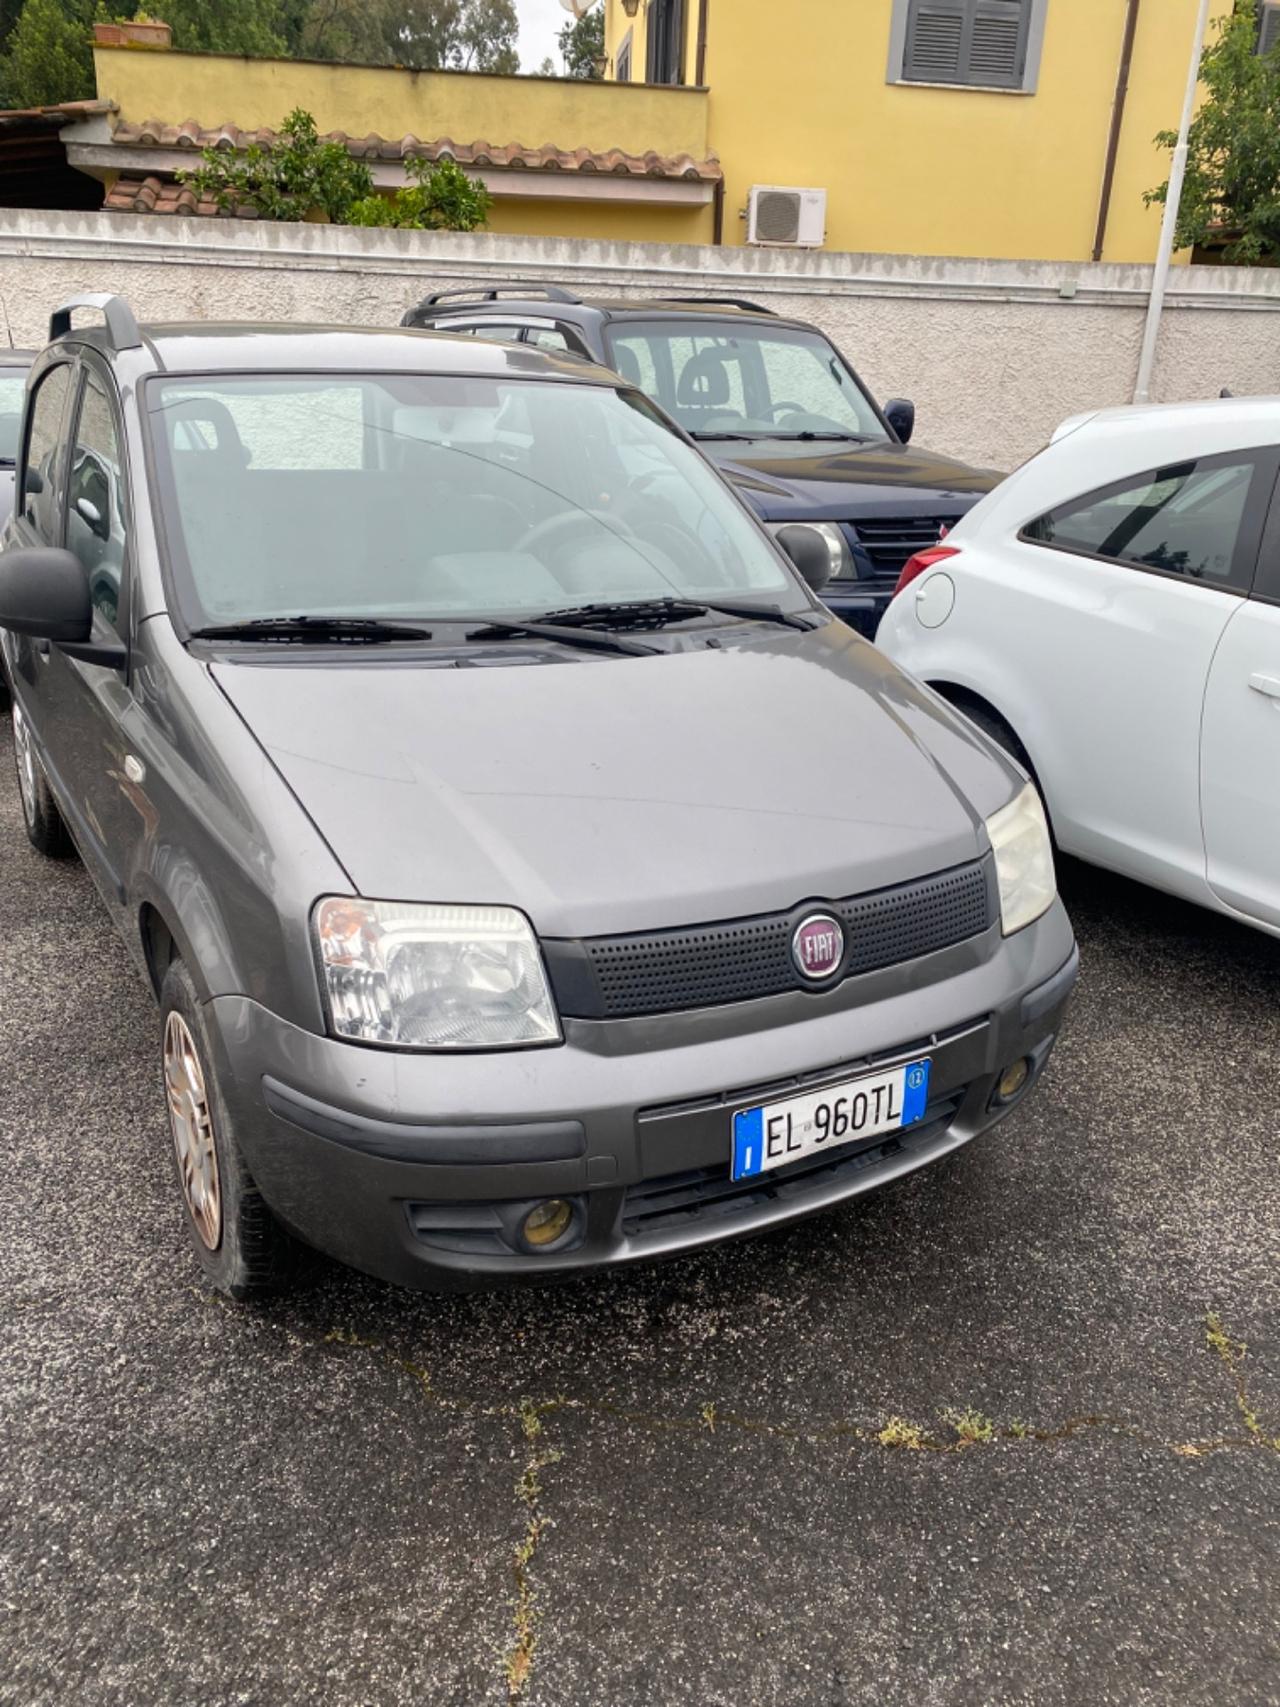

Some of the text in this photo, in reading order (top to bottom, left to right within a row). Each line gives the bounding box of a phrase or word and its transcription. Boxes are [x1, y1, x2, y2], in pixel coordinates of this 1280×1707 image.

[805, 932, 834, 964] FIAT
[767, 1083, 901, 1158] EL 960TL
[744, 1146, 753, 1170] I
